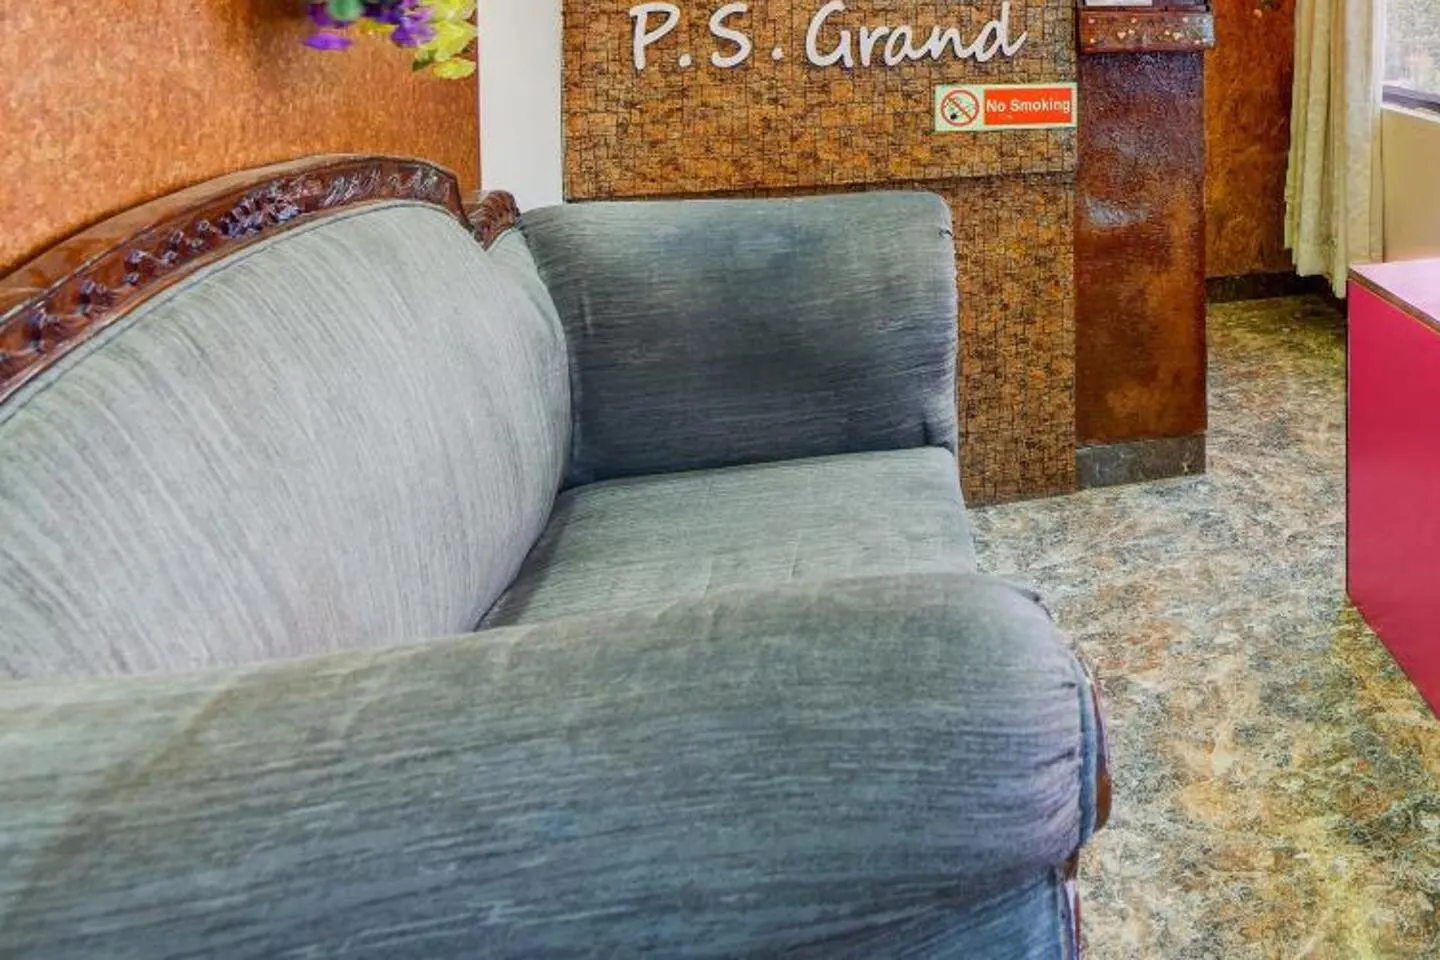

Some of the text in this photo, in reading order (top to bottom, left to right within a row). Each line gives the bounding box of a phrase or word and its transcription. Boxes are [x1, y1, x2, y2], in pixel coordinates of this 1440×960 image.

[805, 0, 1028, 68] Grand
[986, 98, 1071, 113] No Smoking
